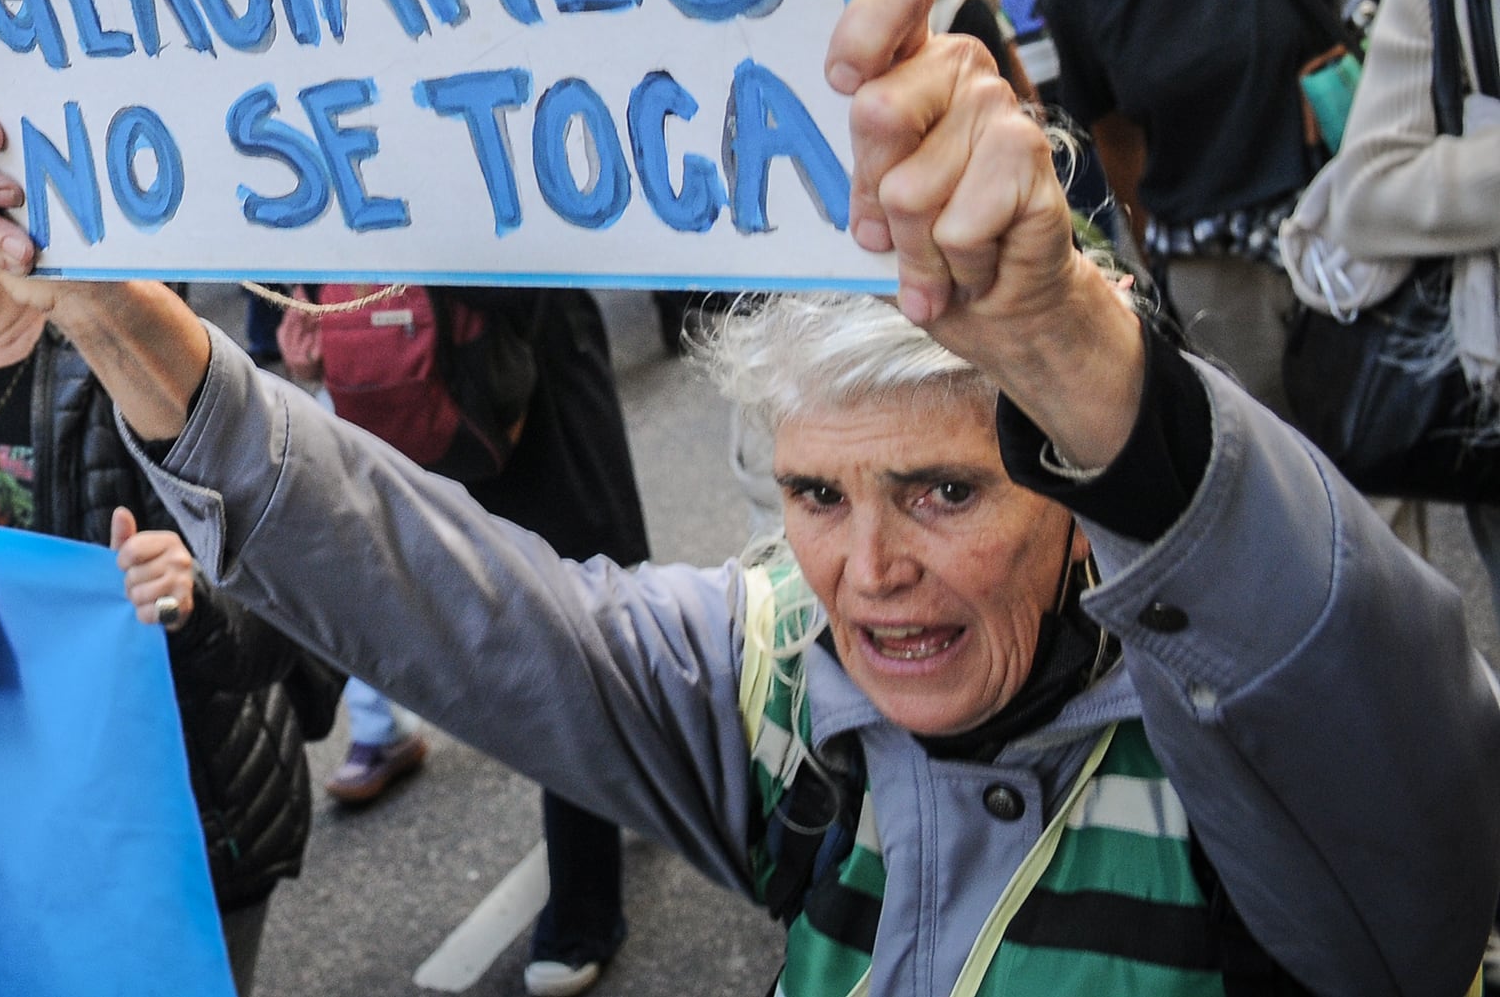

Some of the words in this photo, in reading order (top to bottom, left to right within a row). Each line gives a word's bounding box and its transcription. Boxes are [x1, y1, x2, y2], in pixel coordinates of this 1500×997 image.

[20, 100, 186, 247] NO
[225, 76, 412, 231] SE
[411, 58, 851, 236] TOCA
